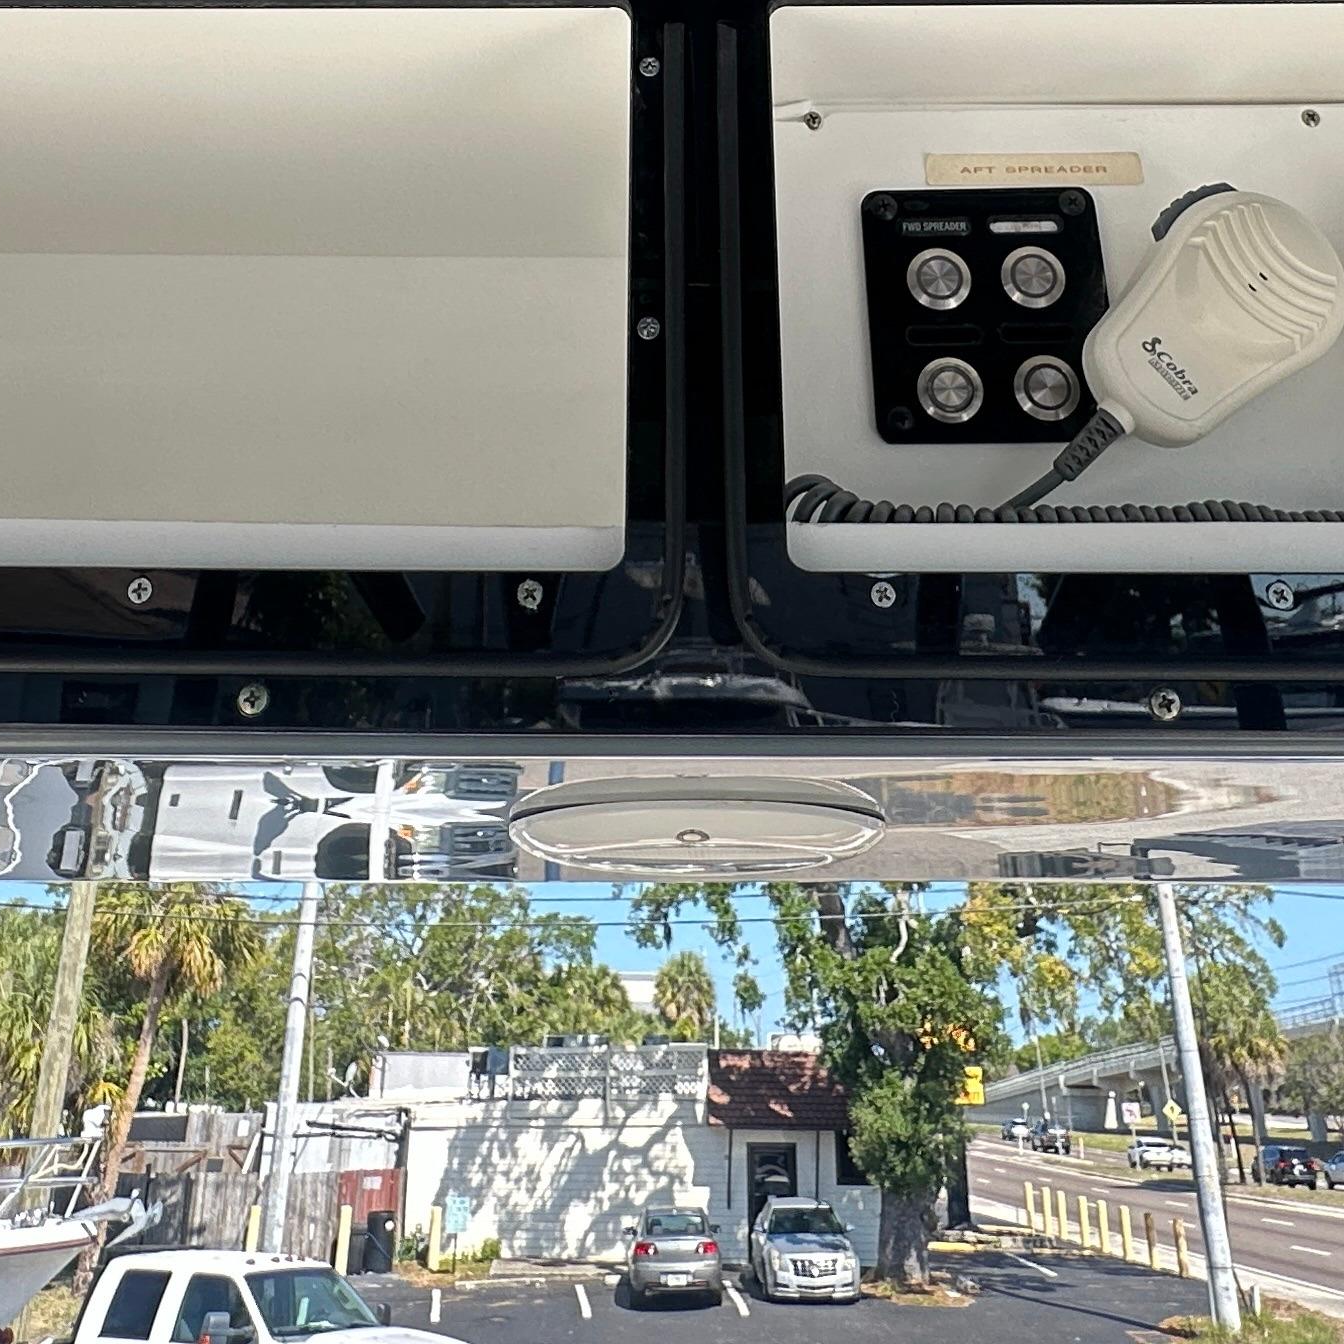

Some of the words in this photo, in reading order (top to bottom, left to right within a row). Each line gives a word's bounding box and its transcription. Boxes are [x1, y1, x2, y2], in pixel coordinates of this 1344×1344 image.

[960, 165, 996, 175] AFT
[1005, 165, 1109, 175] SPREADER
[903, 221, 922, 232] FWD
[923, 220, 967, 232] SPREADER
[1156, 351, 1199, 396] Cobra
